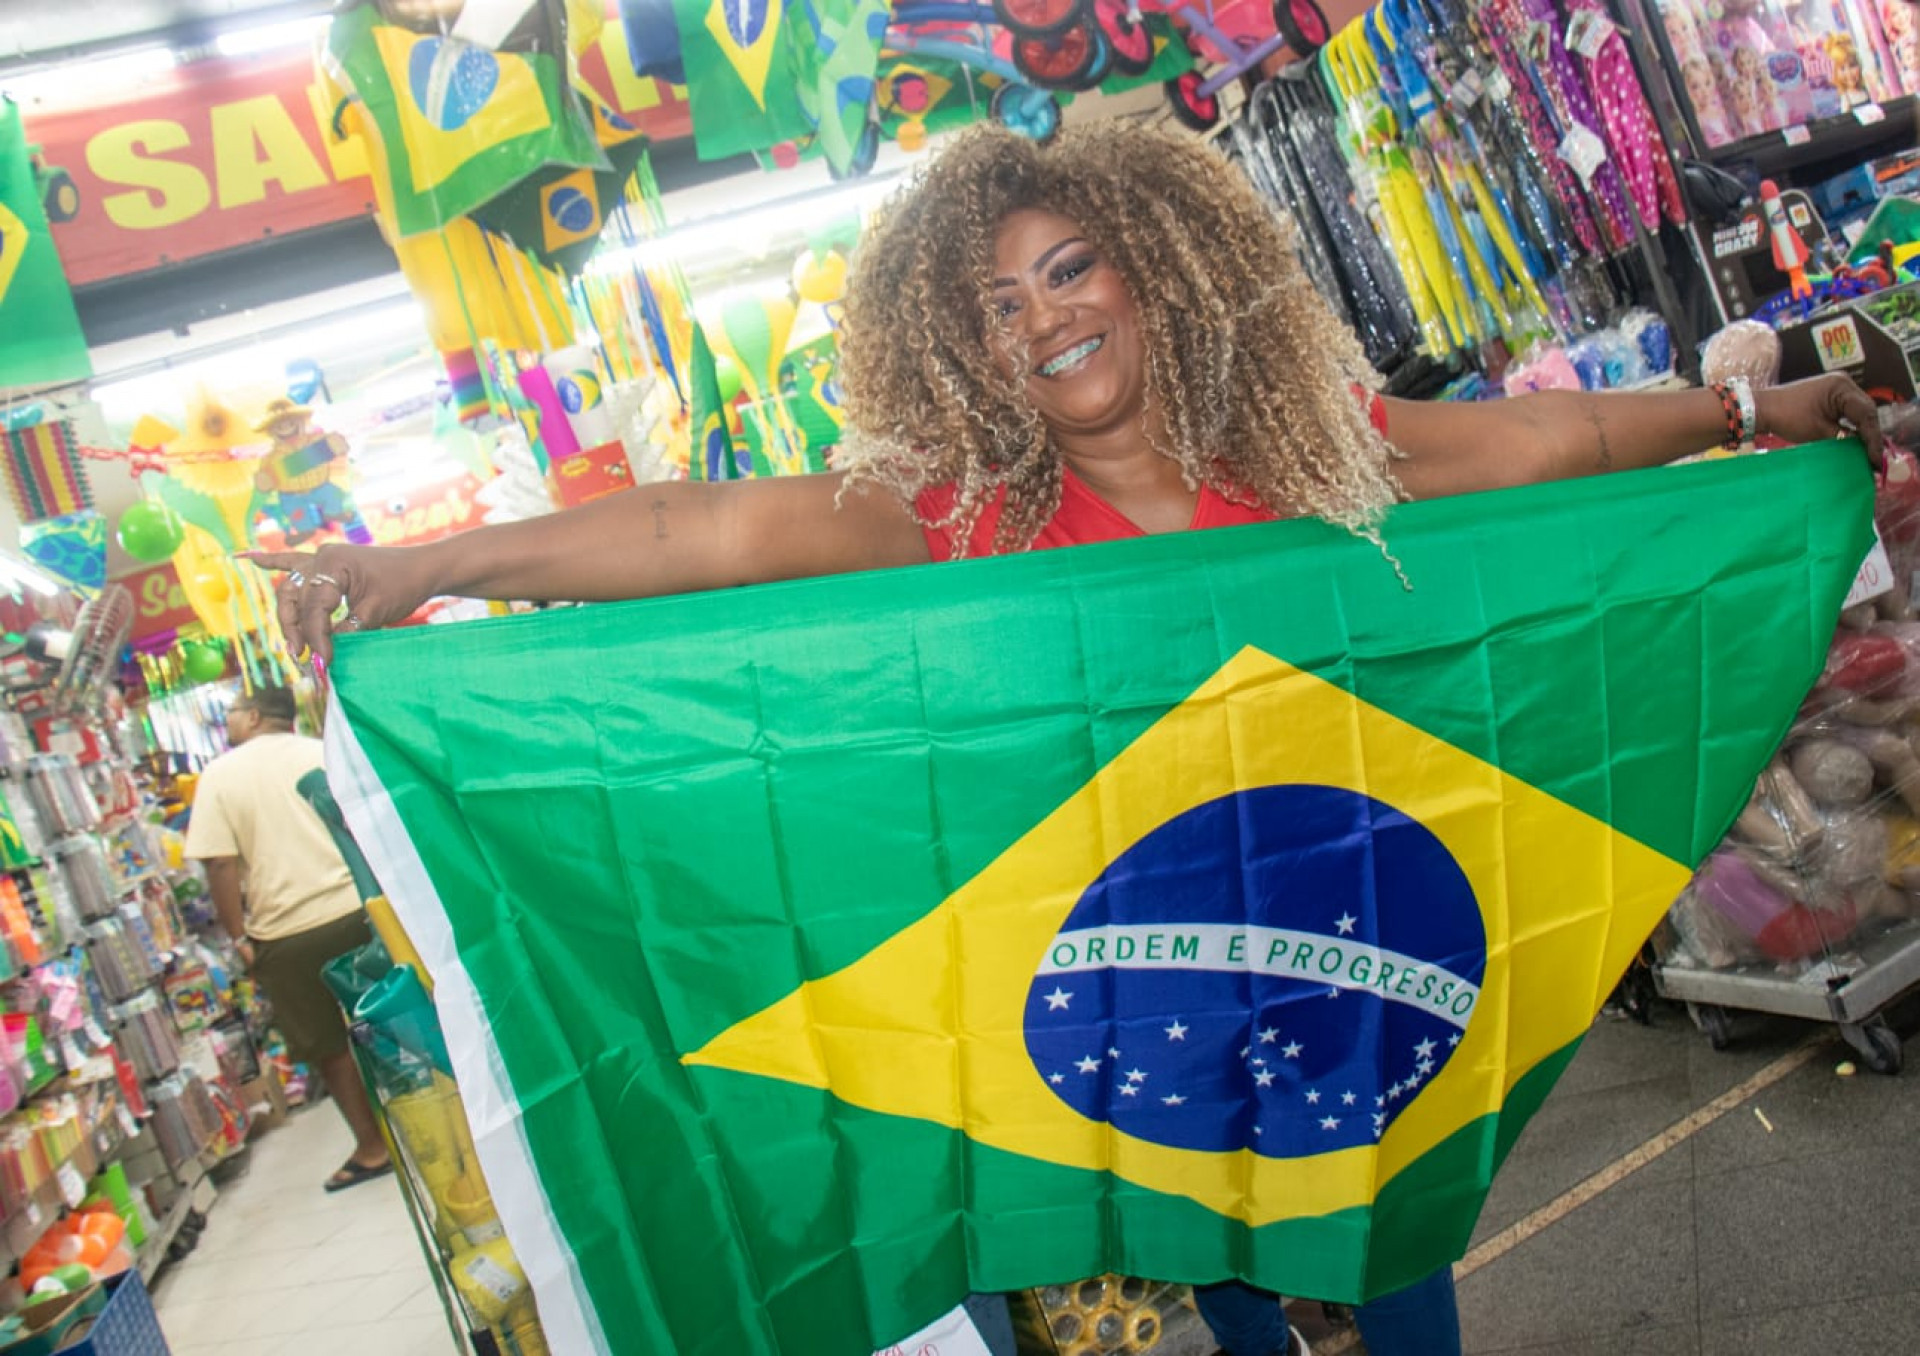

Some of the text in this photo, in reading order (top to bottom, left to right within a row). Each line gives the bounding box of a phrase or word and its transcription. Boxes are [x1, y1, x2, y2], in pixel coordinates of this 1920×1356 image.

[1052, 933, 1475, 1017] ORDEM E PROGRESSO
